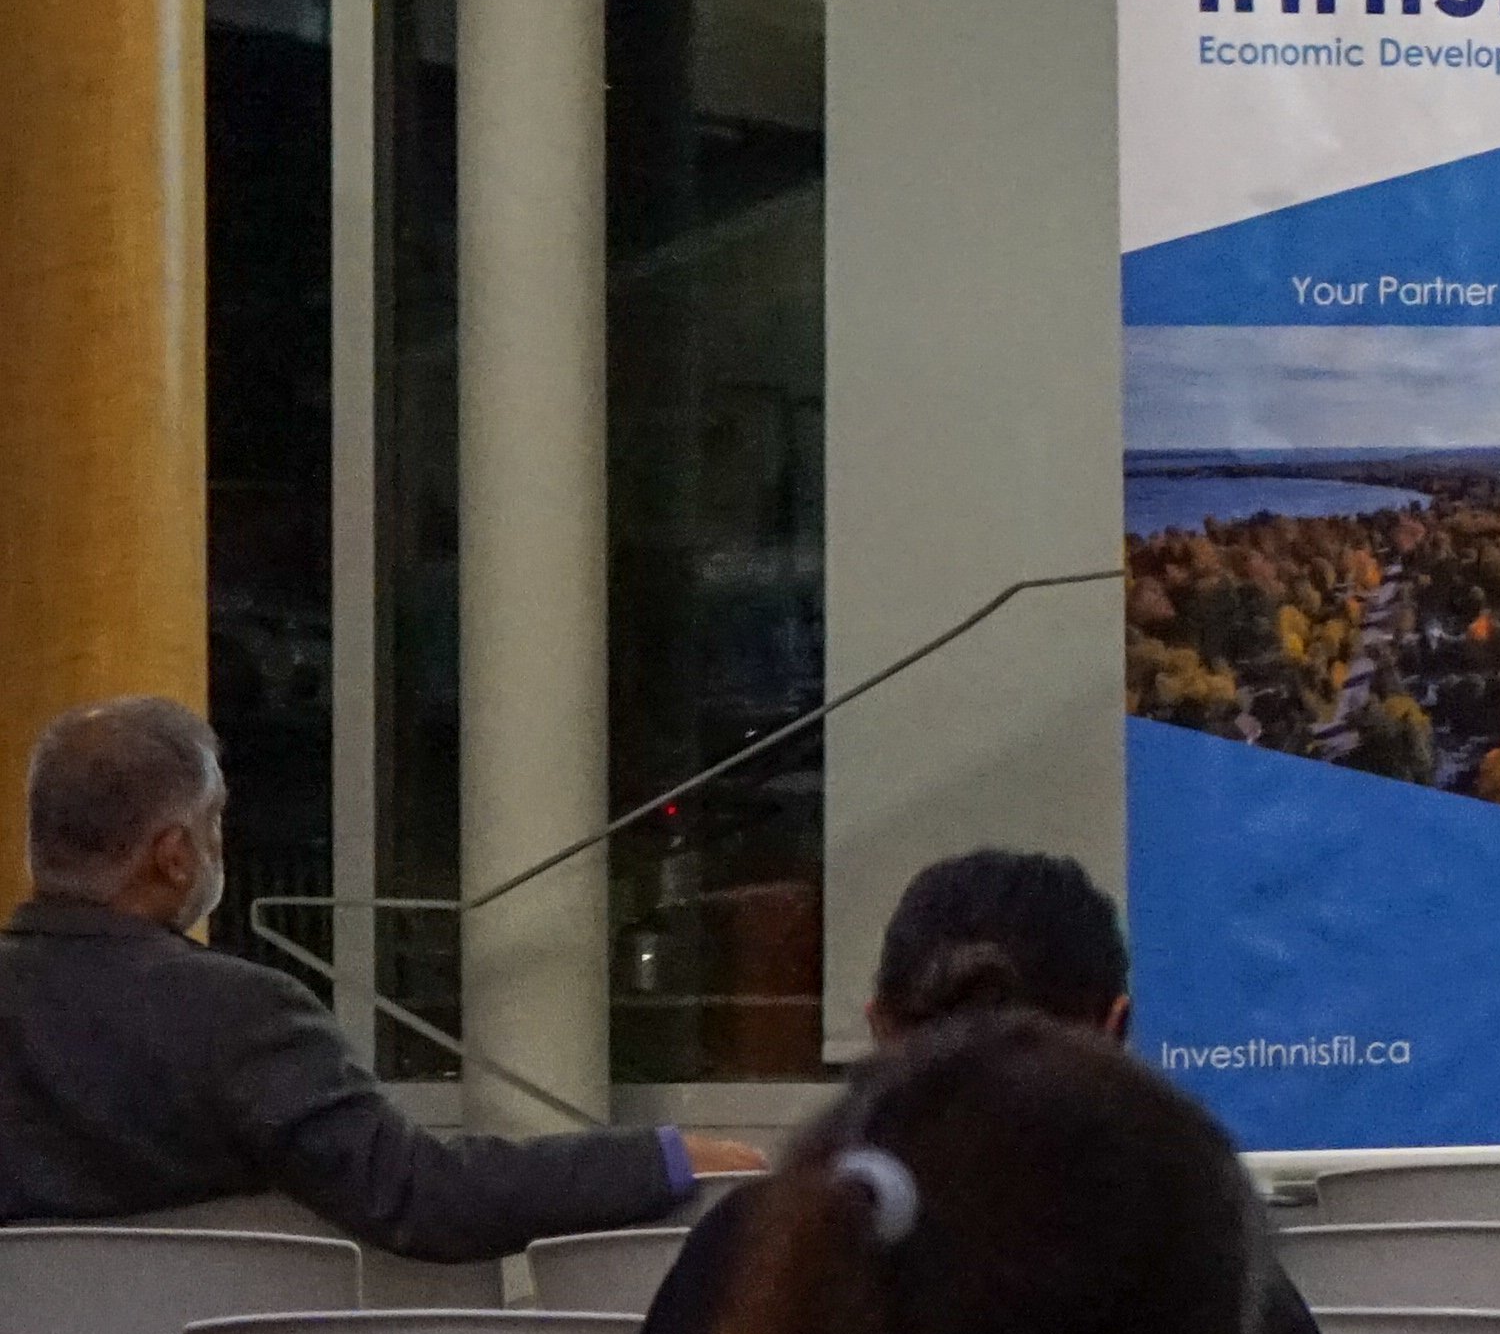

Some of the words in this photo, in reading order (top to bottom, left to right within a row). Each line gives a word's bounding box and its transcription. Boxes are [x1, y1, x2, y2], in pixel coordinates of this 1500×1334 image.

[1199, 35, 1365, 68] Economic
[1292, 277, 1369, 305] Your
[1379, 275, 1498, 307] Partner
[1162, 1036, 1410, 1069] InvestInnisfil.ca
